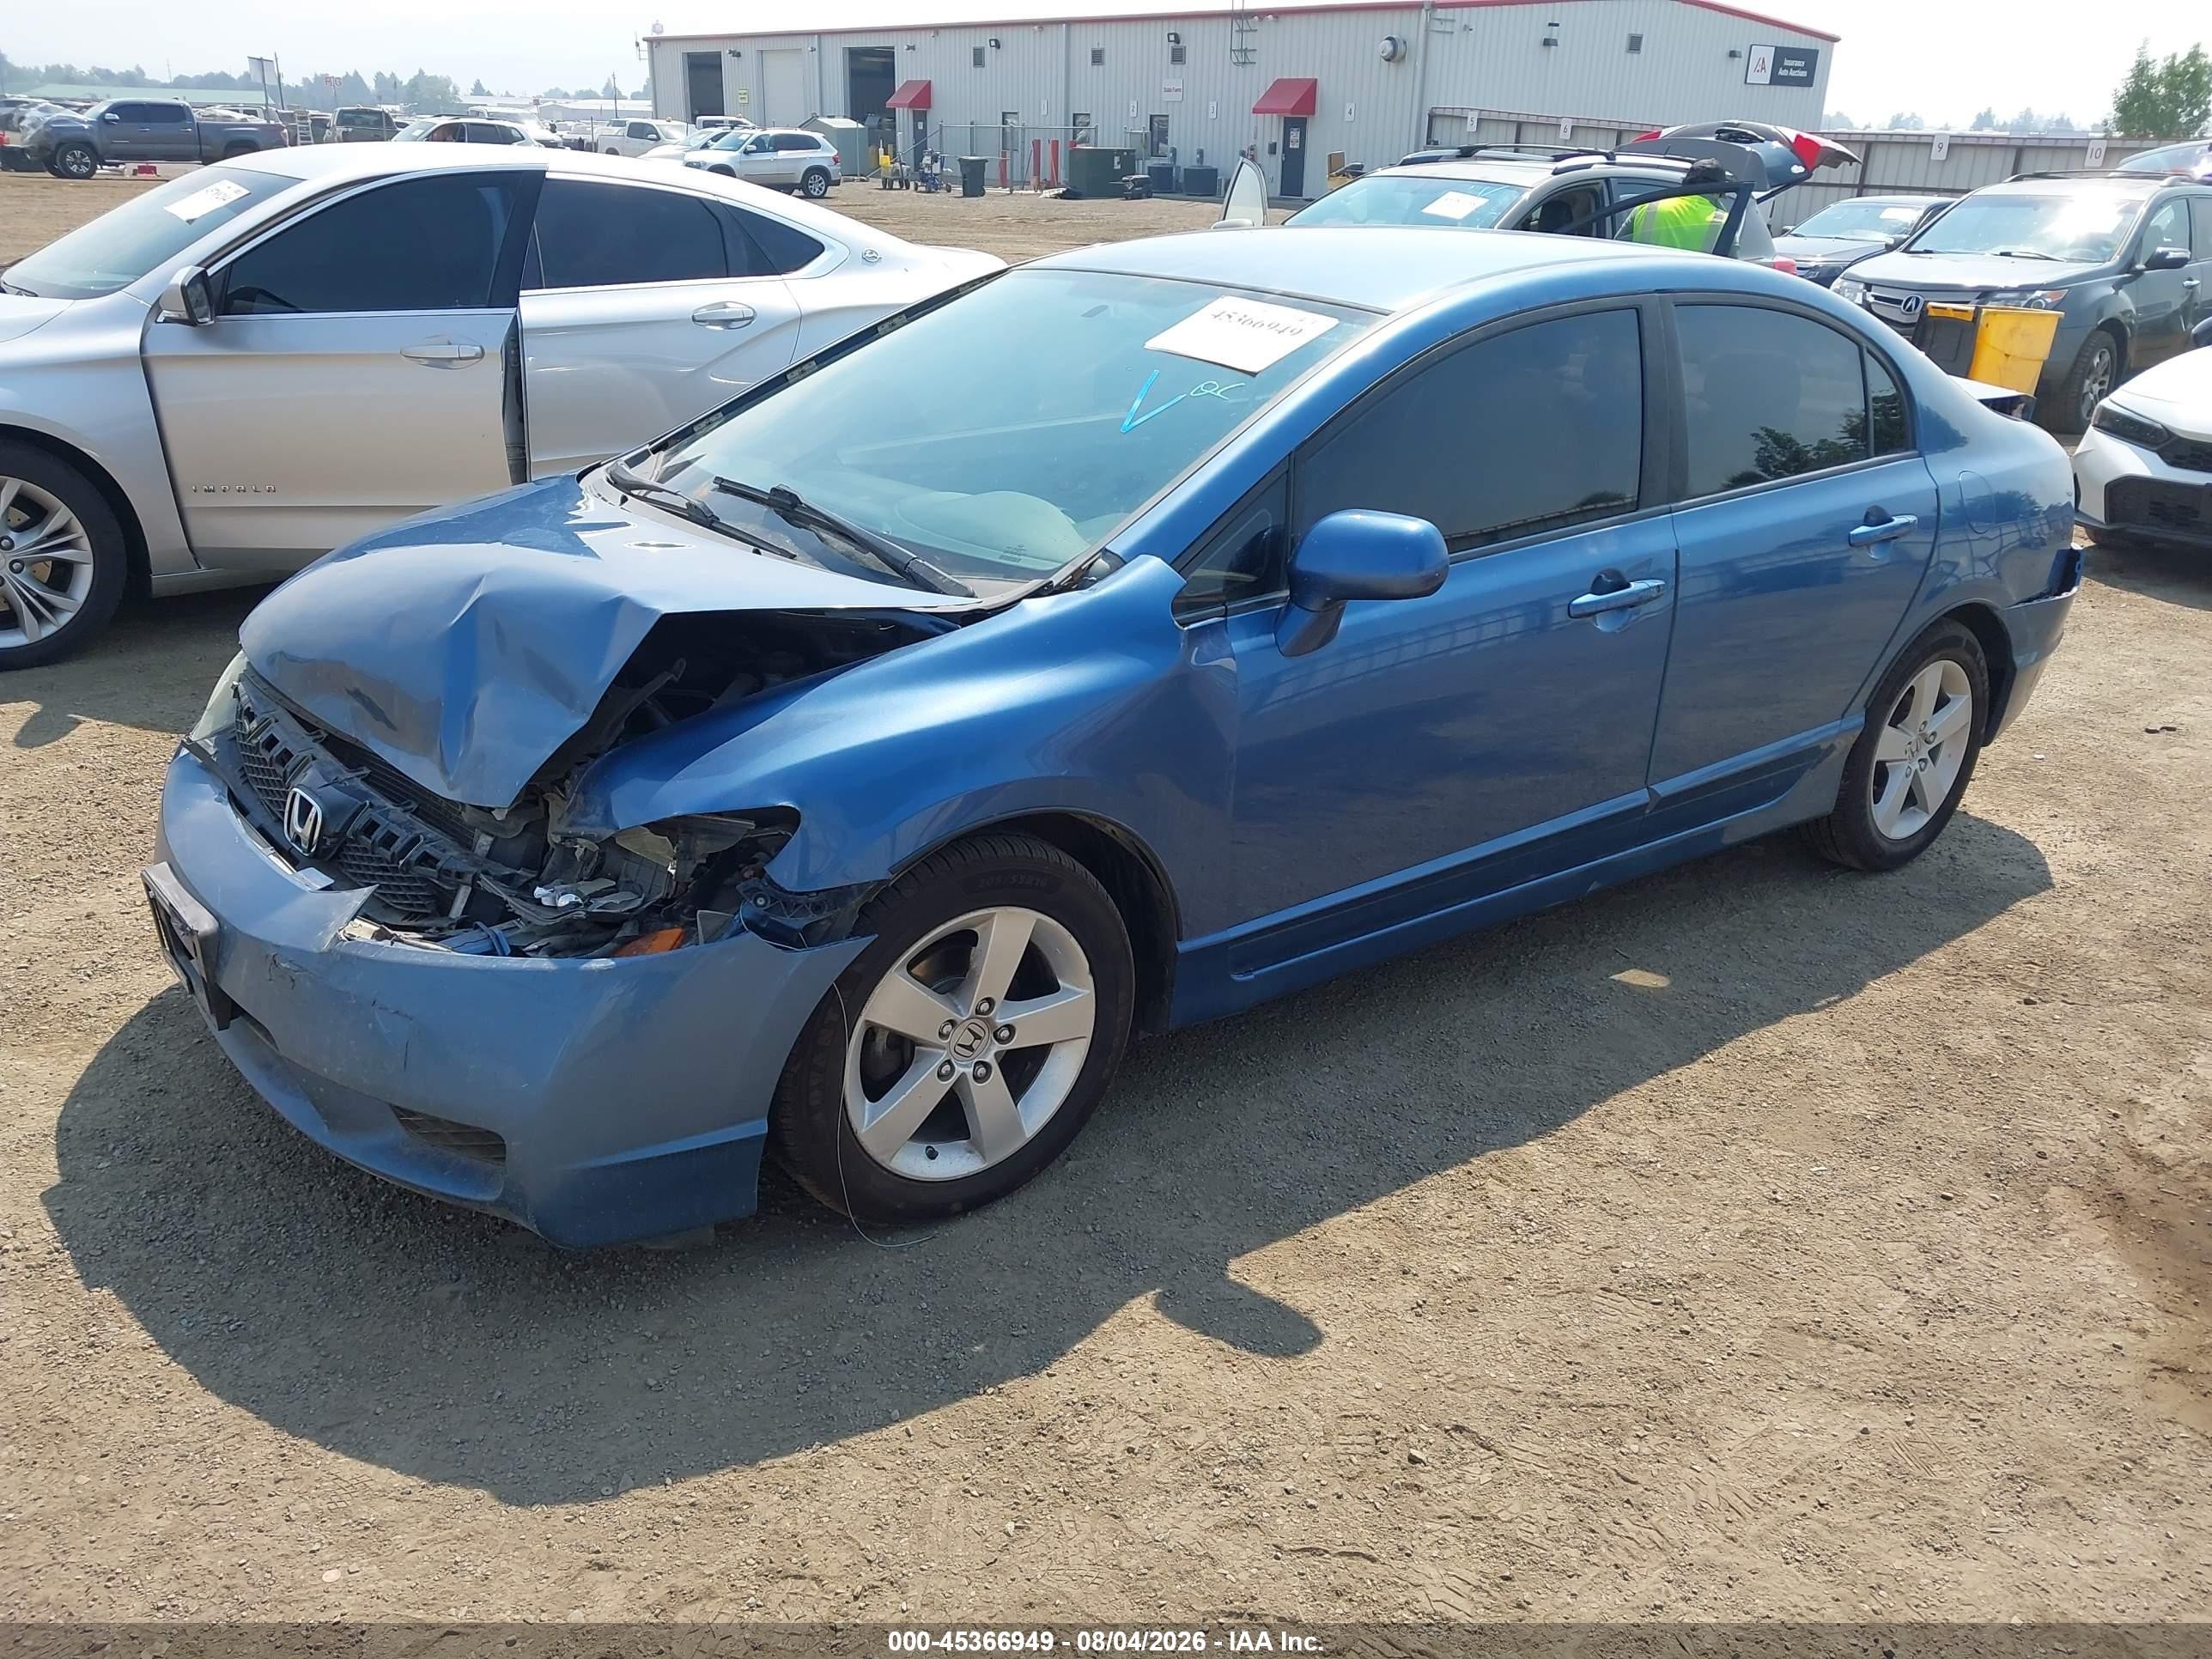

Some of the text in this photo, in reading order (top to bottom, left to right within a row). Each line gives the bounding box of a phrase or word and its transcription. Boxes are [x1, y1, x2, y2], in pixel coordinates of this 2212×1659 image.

[1469, 118, 1474, 126] 5
[1563, 124, 1568, 133] 6
[1937, 142, 1943, 153] 9
[2089, 148, 2102, 159] 10
